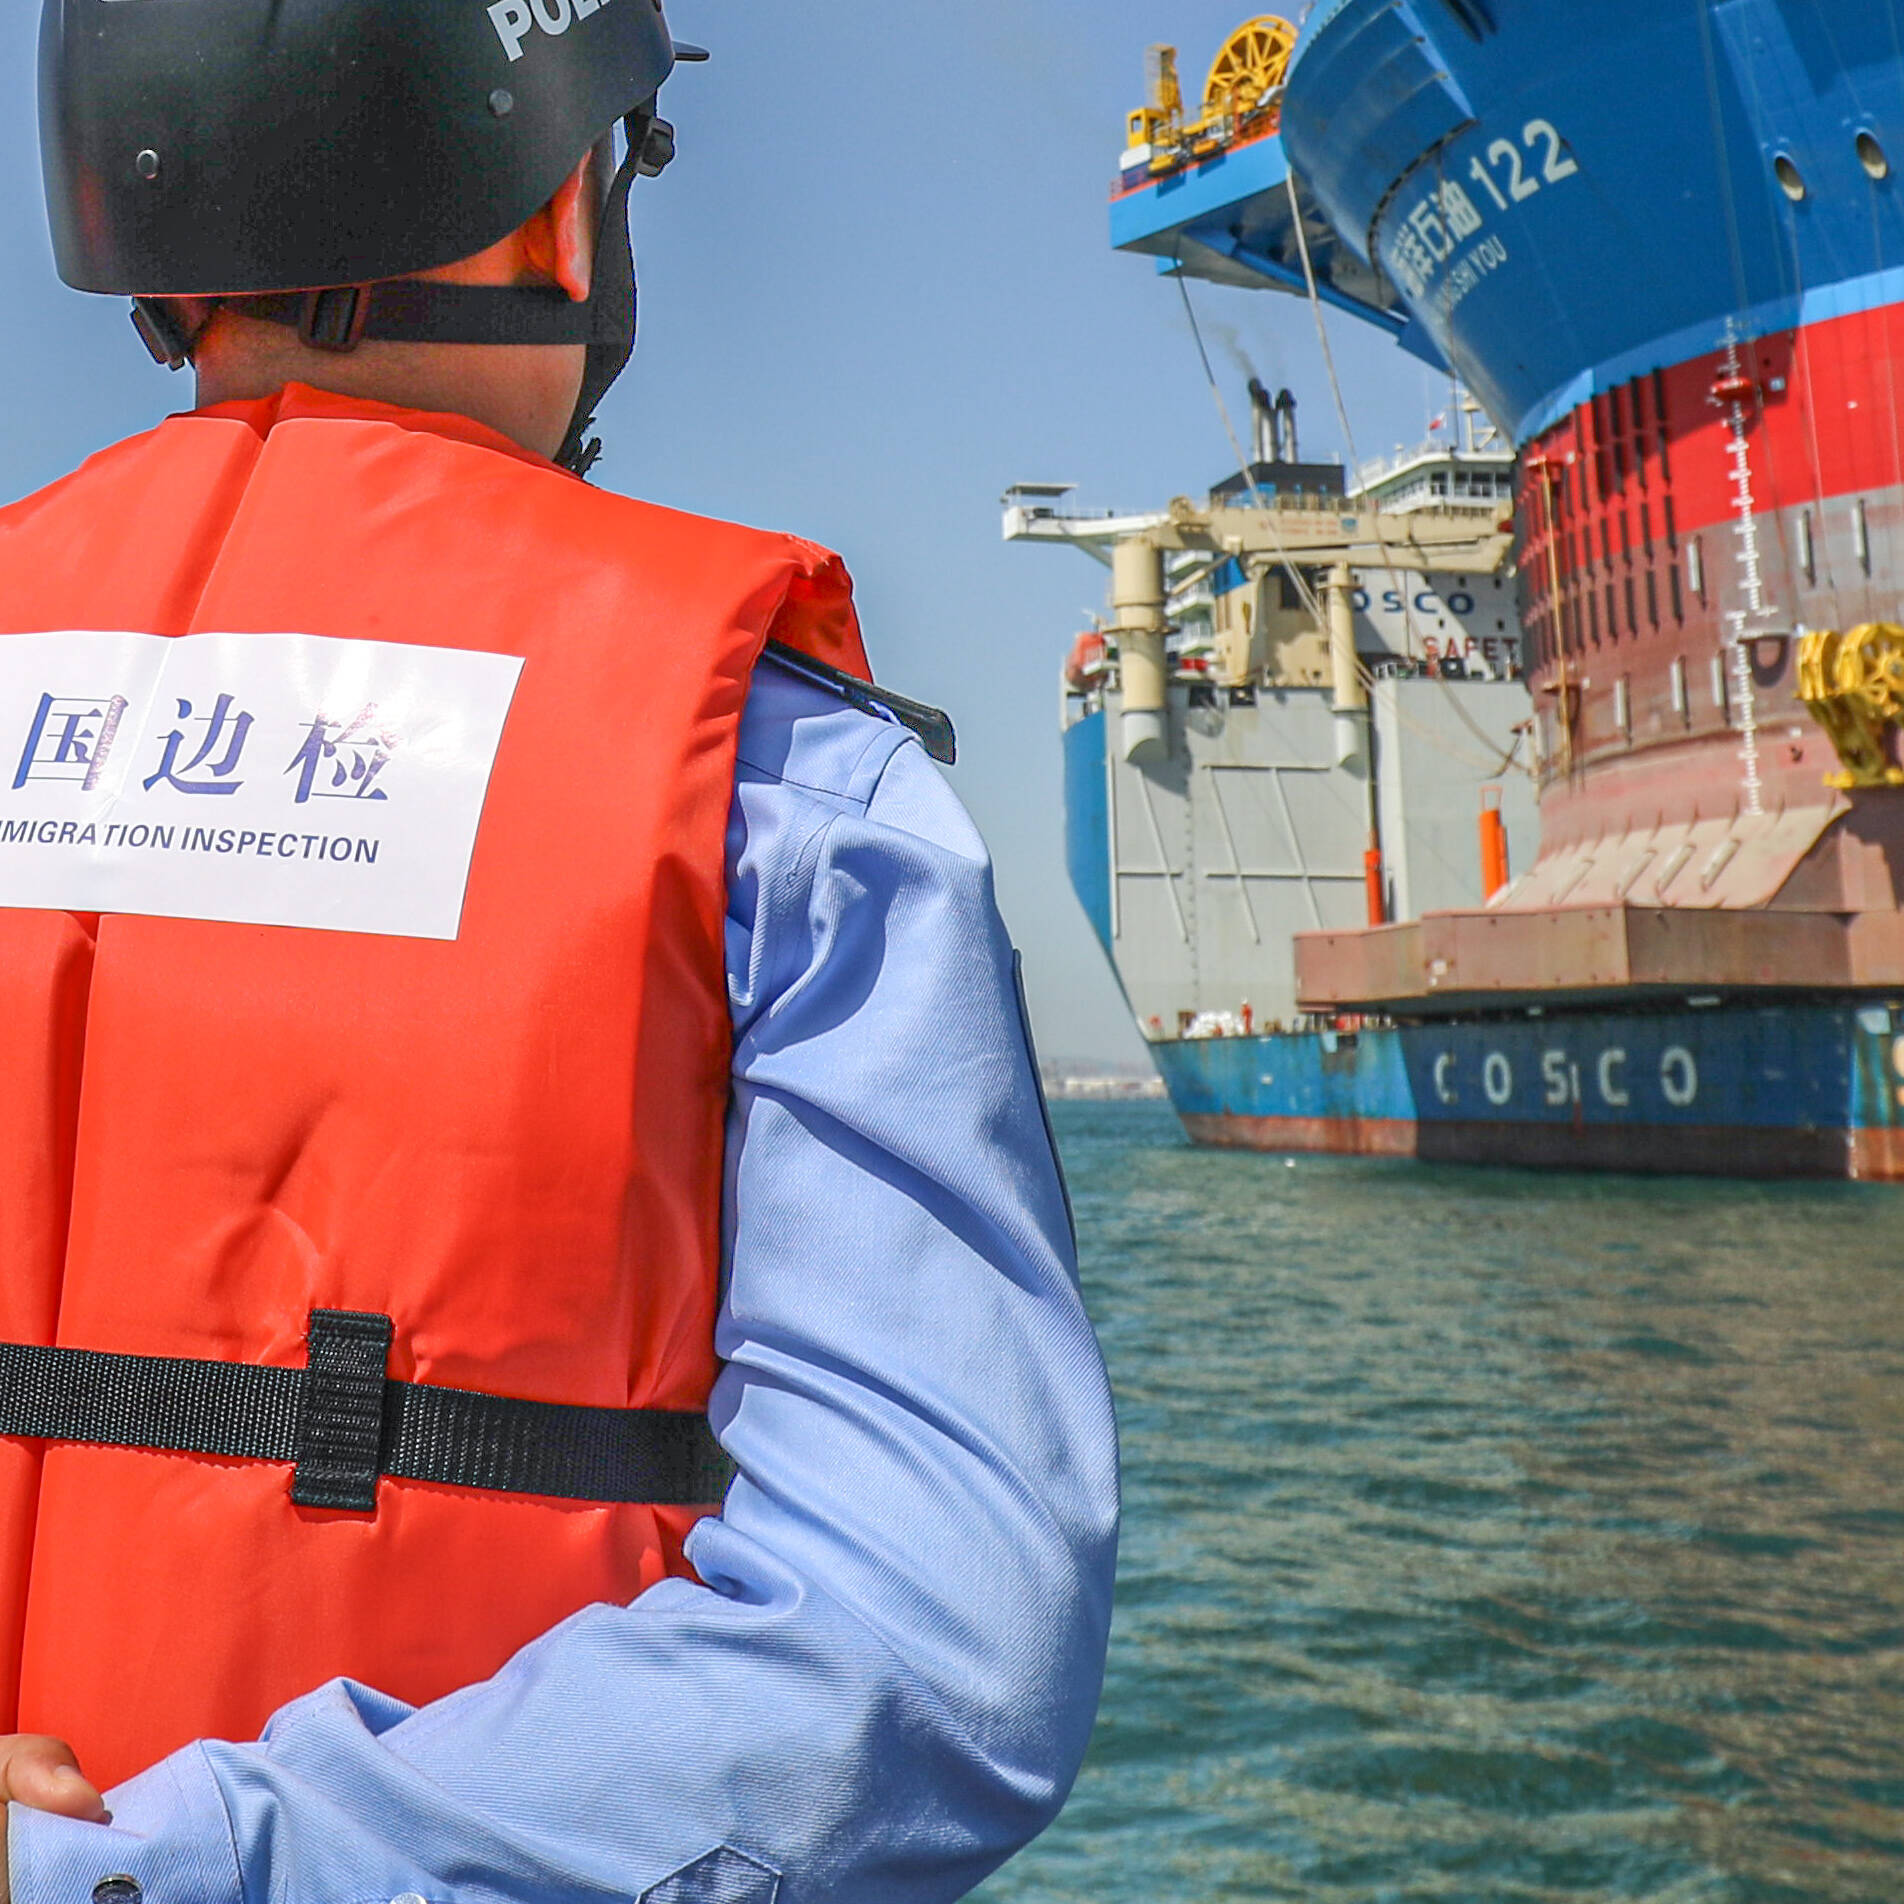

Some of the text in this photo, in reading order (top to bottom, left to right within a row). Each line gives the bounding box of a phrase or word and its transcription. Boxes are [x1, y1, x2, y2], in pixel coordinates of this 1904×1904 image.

[1469, 119, 1578, 211] 122
[1470, 235, 1507, 276] YOU
[1352, 590, 1475, 614] OSCO
[1423, 637, 1519, 660] SAFET
[179, 826, 381, 863] INSPECTION
[1434, 1045, 1699, 1107] COSCO
